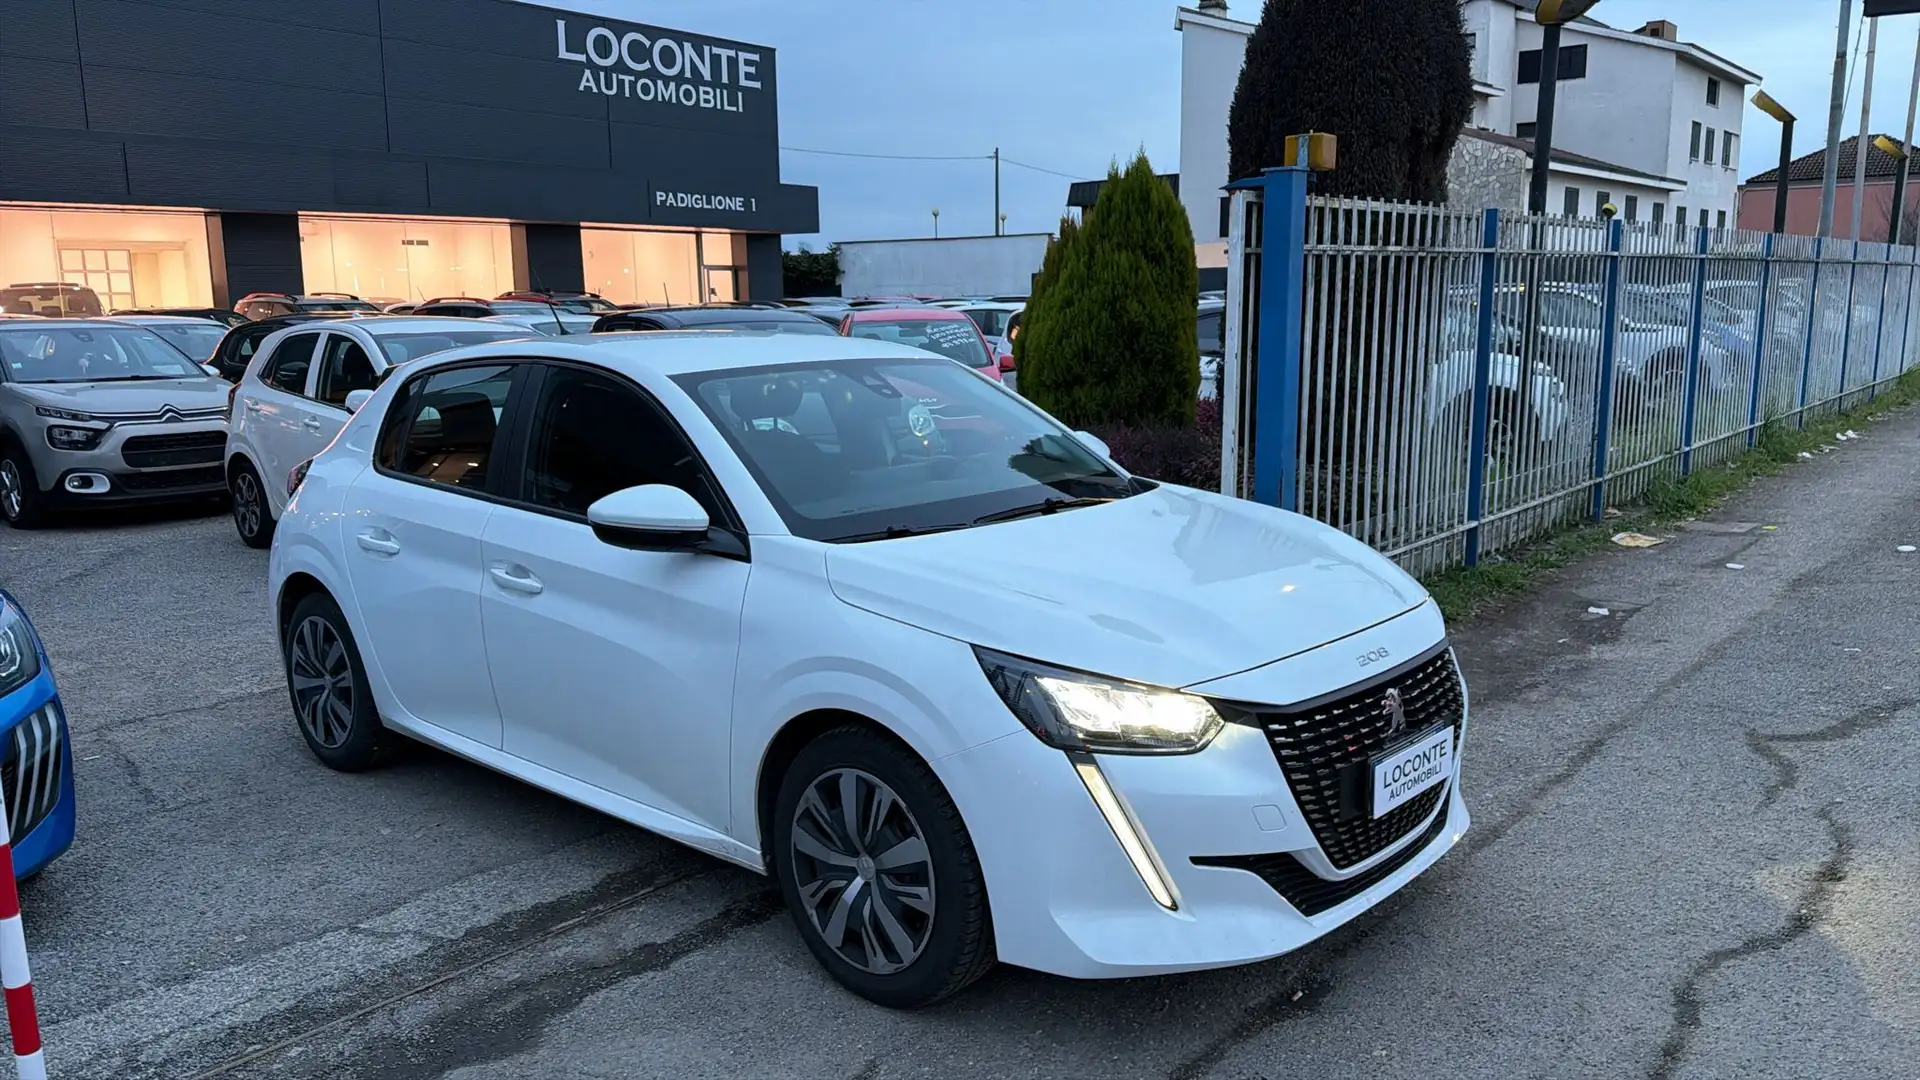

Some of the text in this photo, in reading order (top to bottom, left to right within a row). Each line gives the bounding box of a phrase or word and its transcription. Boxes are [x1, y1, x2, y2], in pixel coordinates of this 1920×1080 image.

[556, 19, 761, 90] LOCONTE
[579, 69, 743, 112] AUTOMOBILI
[655, 191, 757, 212] PADIGLIONE 1
[1383, 738, 1448, 789] LOCONTE
[1388, 762, 1442, 802] AUTOMOBILI
